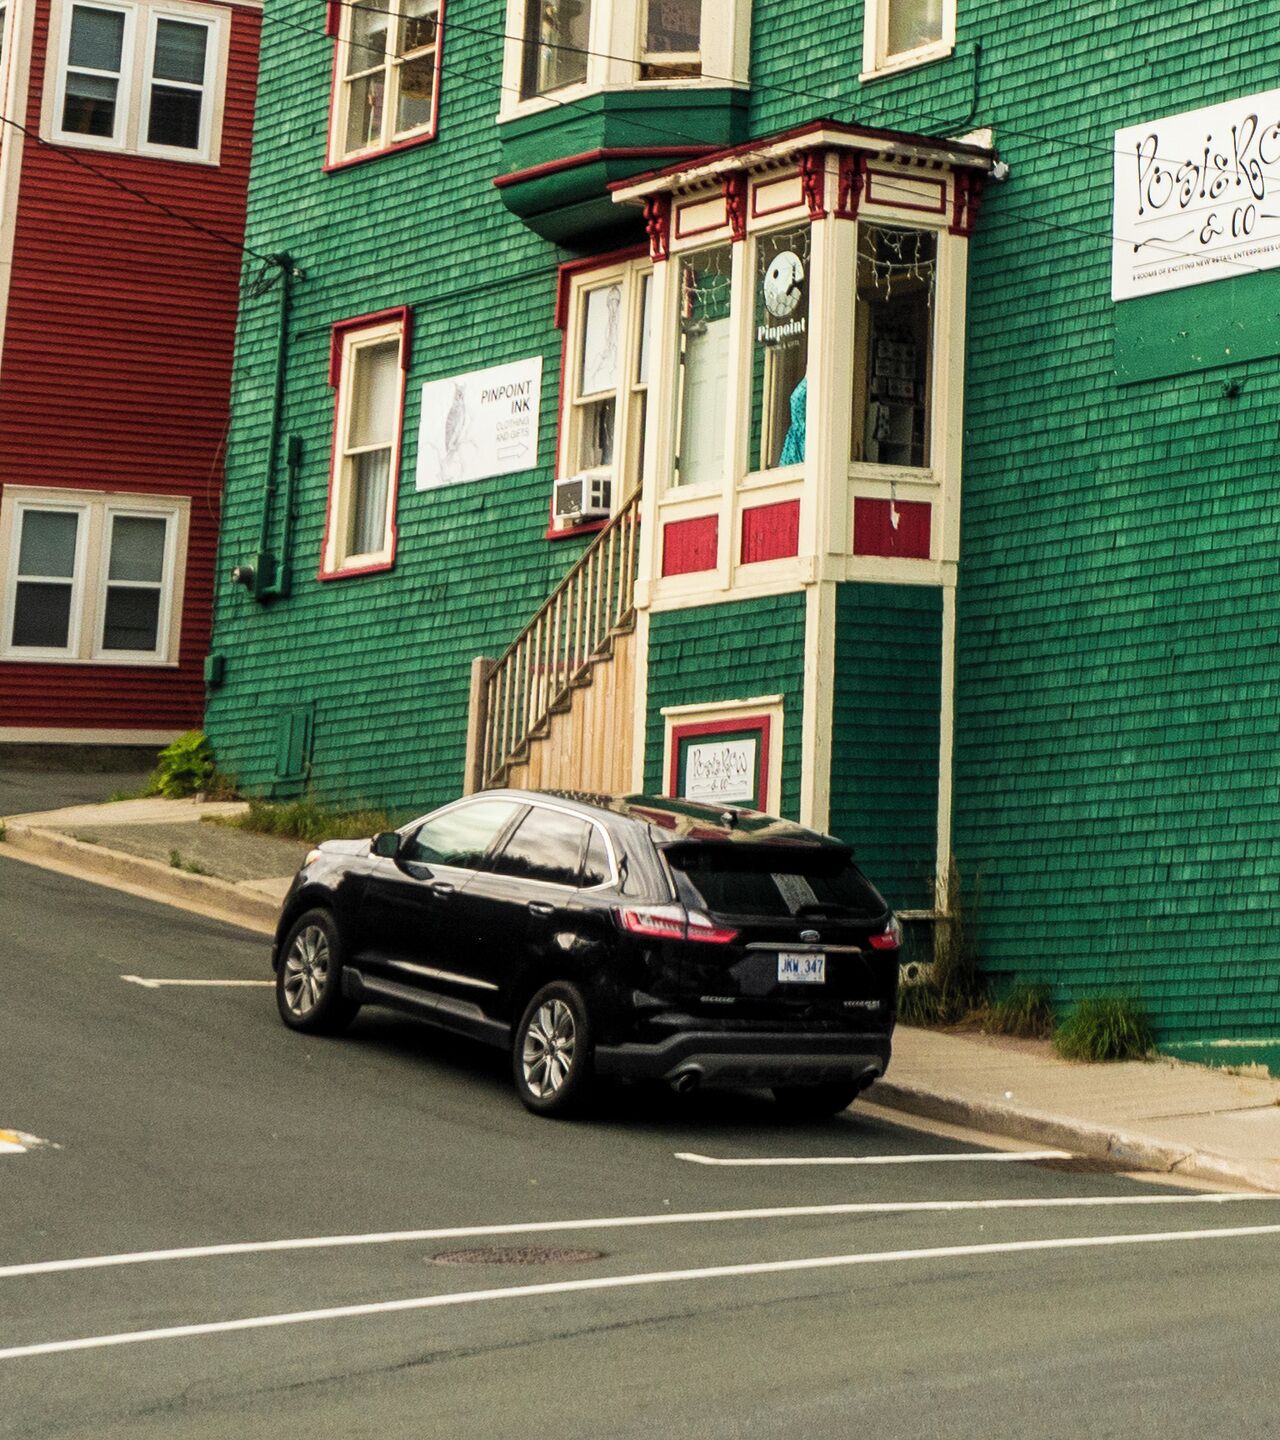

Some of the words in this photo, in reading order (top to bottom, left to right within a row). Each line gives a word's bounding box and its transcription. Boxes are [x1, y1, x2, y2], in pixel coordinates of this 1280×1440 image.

[1199, 212, 1225, 244] &
[1137, 269, 1158, 280] ROOMS
[1159, 267, 1167, 276] OF
[1167, 261, 1195, 274] EXCITING
[1196, 258, 1210, 269] NEW
[1233, 245, 1275, 259] ENTERPRISES
[757, 317, 806, 342] Pinpoint
[480, 380, 532, 404] PINPOINT
[511, 398, 530, 414] INK
[496, 415, 530, 432] CLOTHING
[496, 430, 509, 442] AND
[511, 426, 530, 439] GIFTS
[781, 959, 799, 974] JKW
[804, 958, 824, 974] 347
